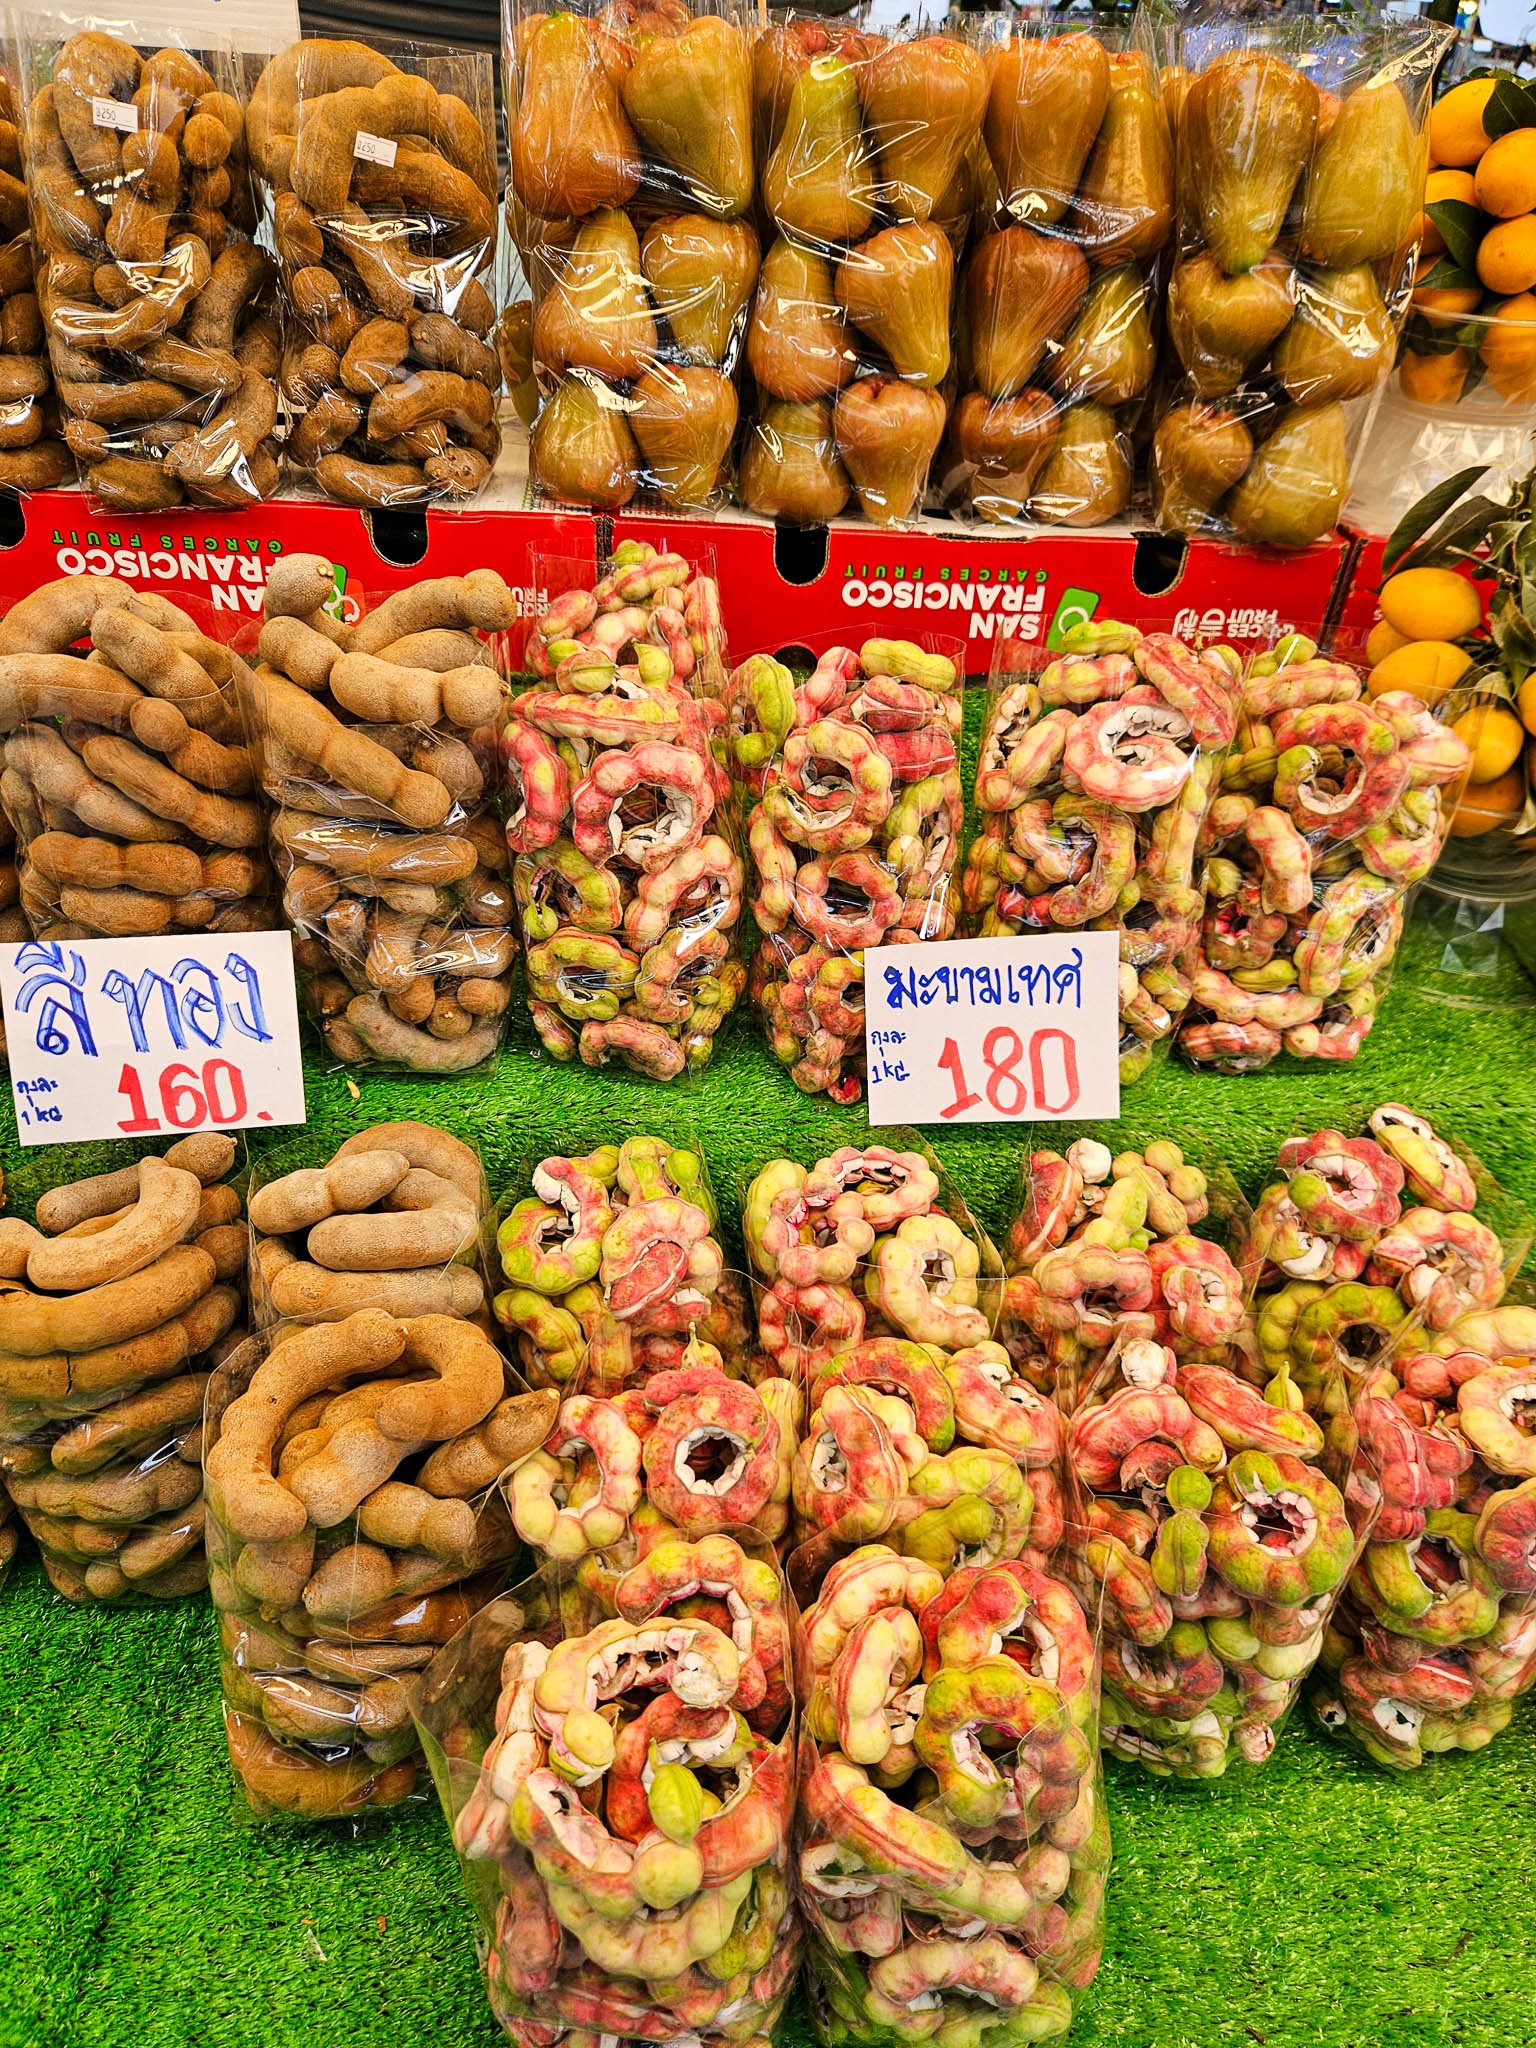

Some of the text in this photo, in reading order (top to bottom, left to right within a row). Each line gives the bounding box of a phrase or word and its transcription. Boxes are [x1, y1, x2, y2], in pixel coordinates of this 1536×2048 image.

[51, 529, 283, 553] GARCES FRUIT
[844, 564, 1048, 582] GARCES FRUIT
[211, 584, 267, 612] AN
[841, 579, 1046, 612] FRANCISCO
[969, 612, 1041, 640] SAN
[883, 947, 1083, 1008] มะขามเทศ
[937, 1026, 1080, 1119] 180
